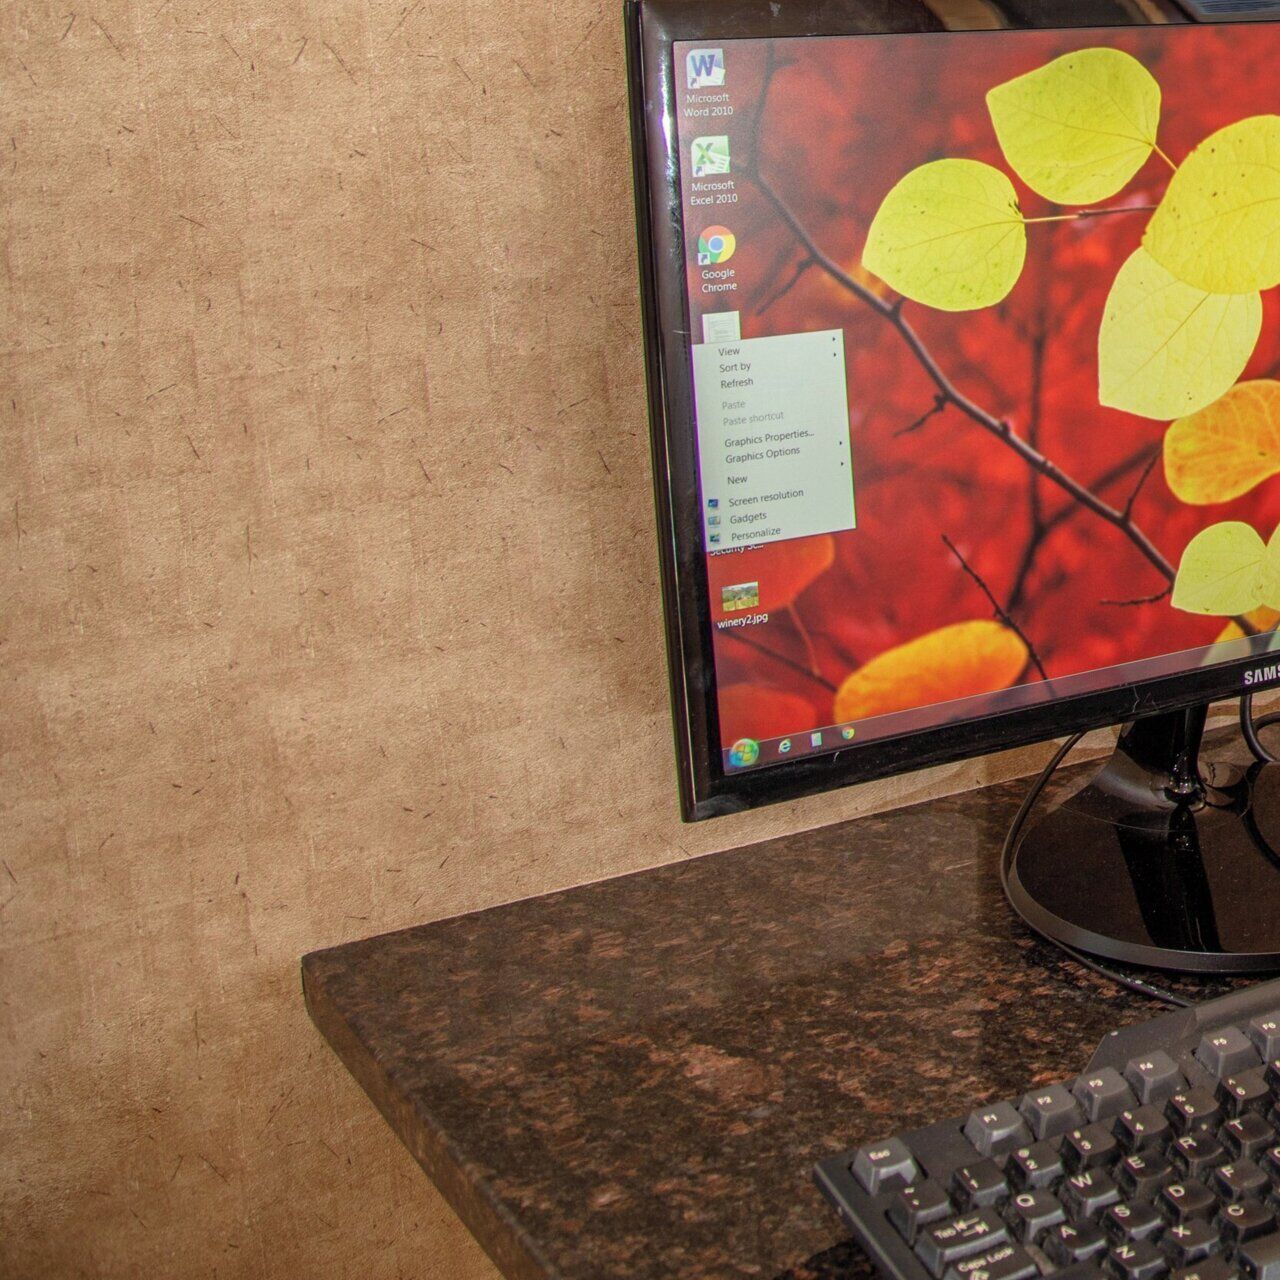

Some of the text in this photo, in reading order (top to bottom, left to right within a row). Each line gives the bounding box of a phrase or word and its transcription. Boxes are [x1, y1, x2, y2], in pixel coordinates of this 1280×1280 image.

[686, 93, 730, 104] Microsoft
[683, 106, 734, 117] Word 2010
[691, 180, 735, 192] Microsoft
[690, 193, 738, 206] Excel 2010
[701, 268, 735, 280] Google
[701, 282, 738, 293] Chrome
[718, 347, 741, 357] View
[719, 362, 751, 373] Sort by
[720, 377, 754, 389] Refresh
[722, 400, 746, 410] Paste
[723, 411, 784, 427] Paste shortcut
[724, 435, 763, 448] Graphics
[725, 447, 801, 464] Graphics Options
[727, 476, 748, 485] New
[728, 489, 804, 507] Screen resolution
[730, 512, 767, 525] Gadgets
[731, 527, 781, 542] Personalize
[716, 613, 769, 629] winery2.jpg
[1229, 1119, 1243, 1131] T
[1178, 1136, 1196, 1149] R
[869, 1149, 890, 1160] Esc
[1127, 1156, 1145, 1169] E
[1221, 1165, 1234, 1178] F
[1071, 1173, 1093, 1188] W
[1168, 1185, 1185, 1197] D
[1016, 1194, 1035, 1207] Q
[1114, 1204, 1130, 1217] S
[1228, 1204, 1244, 1216] C
[934, 1228, 956, 1239] Tab
[1060, 1225, 1077, 1238] A
[1171, 1225, 1191, 1238] X
[1116, 1245, 1135, 1259] Z
[957, 1247, 1016, 1272] Caps Lock
